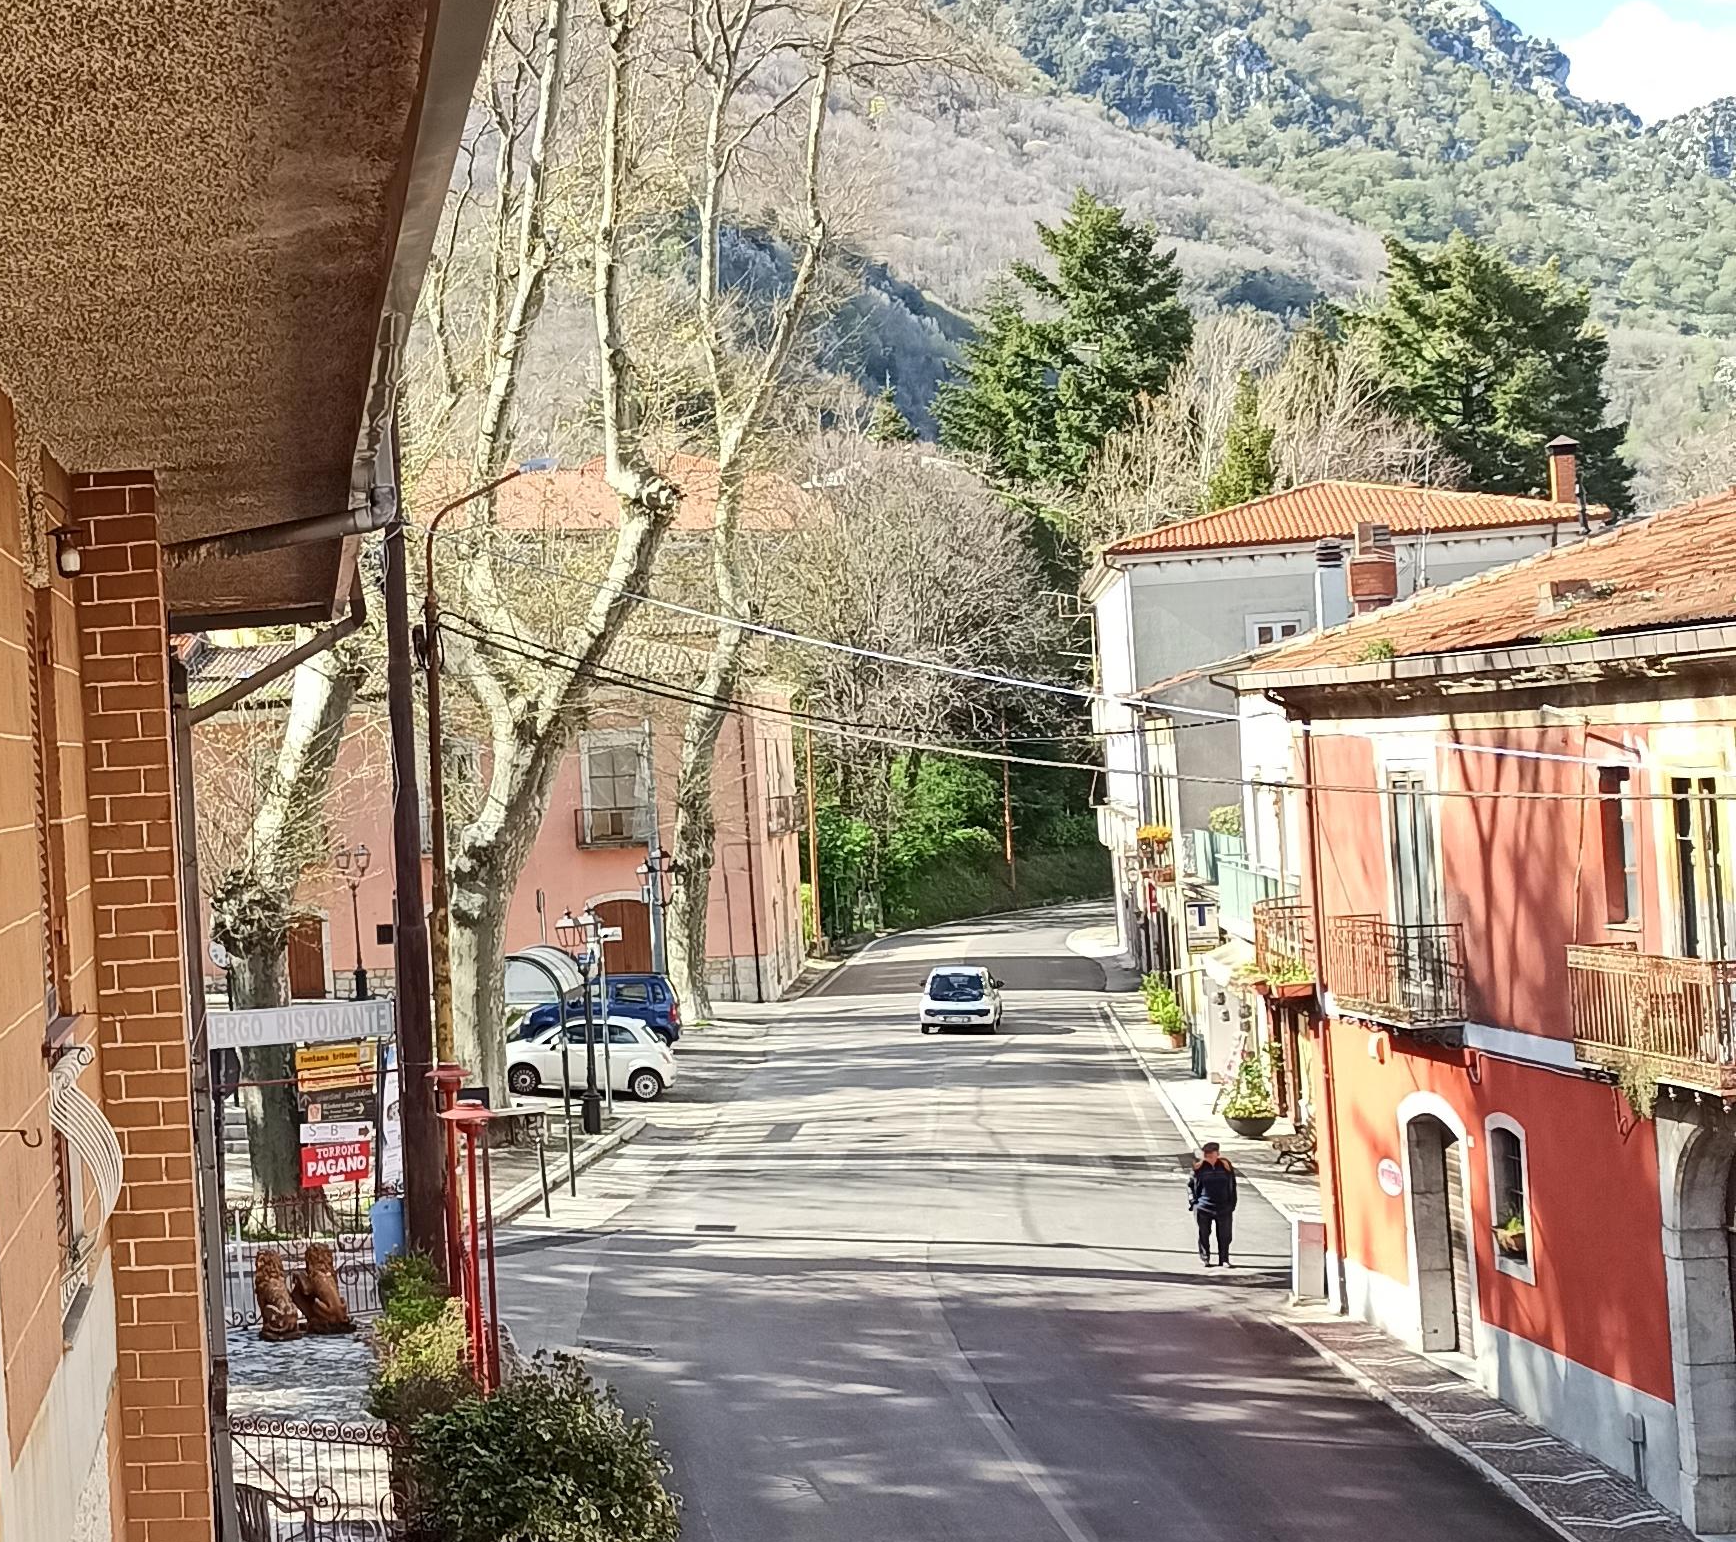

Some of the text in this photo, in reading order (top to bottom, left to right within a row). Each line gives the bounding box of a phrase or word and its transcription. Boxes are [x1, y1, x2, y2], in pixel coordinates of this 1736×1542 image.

[276, 1004, 388, 1039] RISTORANTE
[316, 1144, 361, 1159] TORRONE
[307, 1155, 367, 1178] PAGANO
